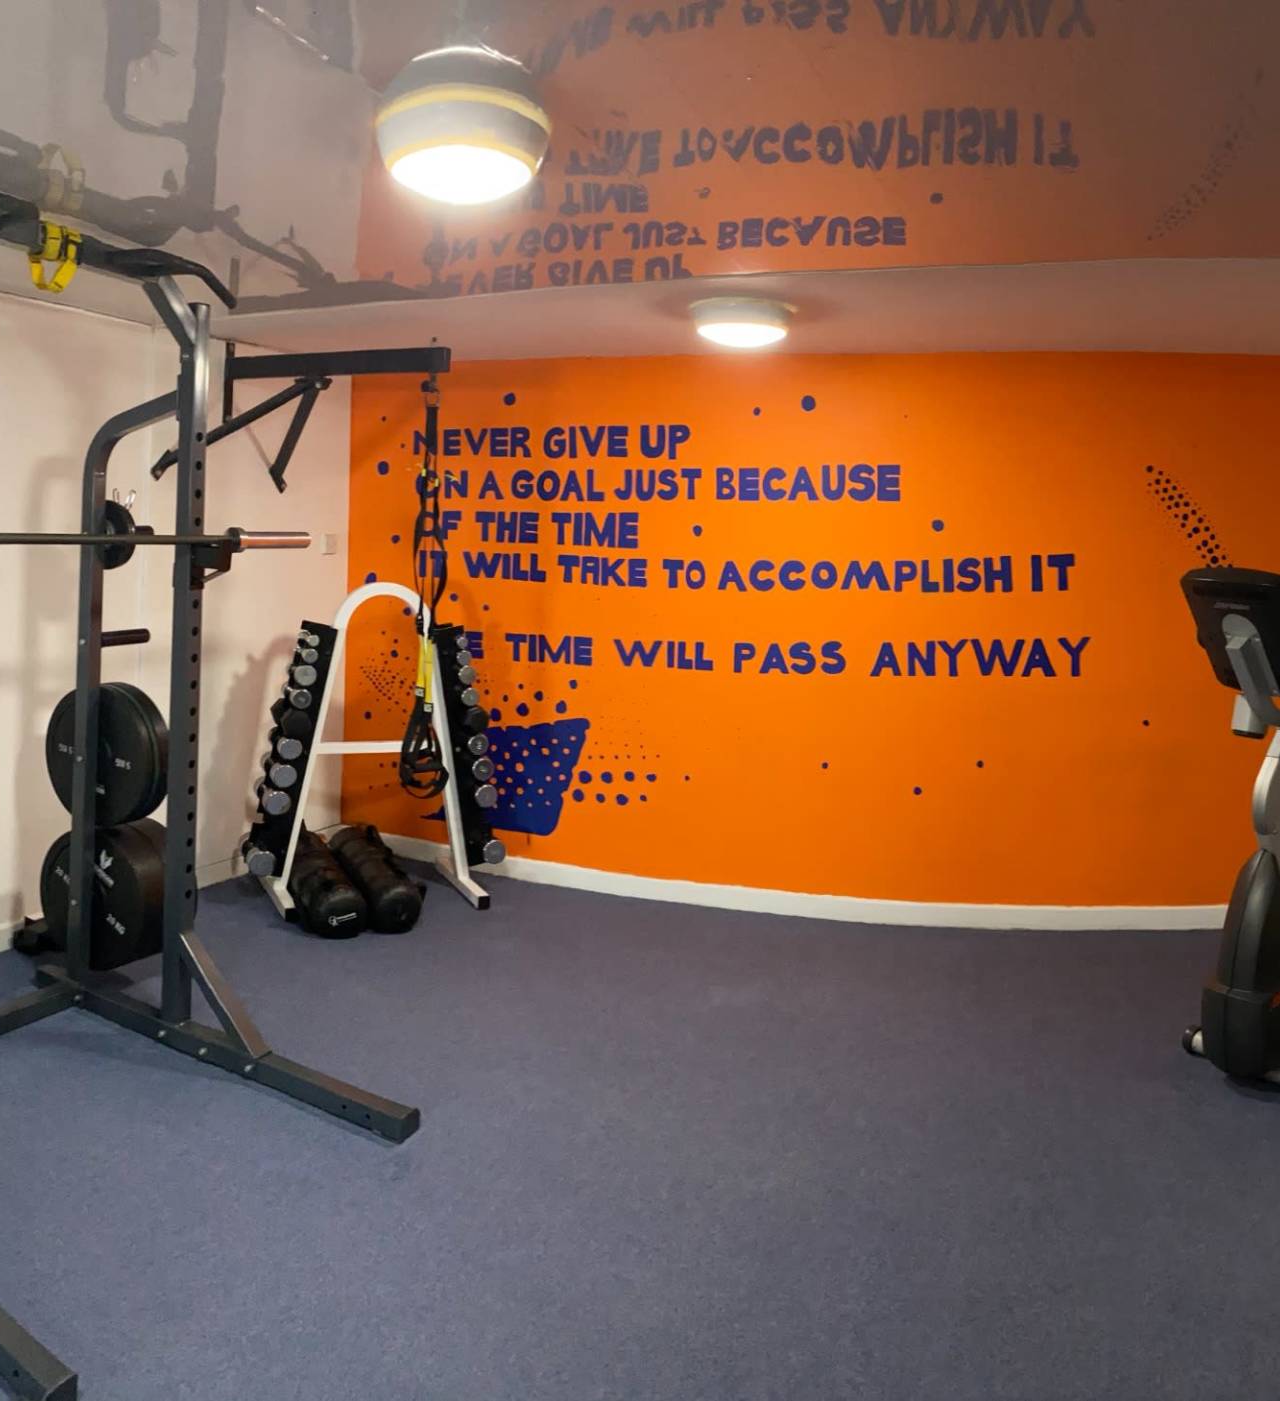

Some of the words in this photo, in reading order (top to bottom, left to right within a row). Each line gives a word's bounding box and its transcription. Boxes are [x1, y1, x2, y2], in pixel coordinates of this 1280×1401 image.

[543, 425, 629, 459] GIVE
[640, 424, 691, 460] UP
[478, 470, 505, 501] A
[511, 469, 606, 502] GOAL
[613, 468, 703, 501] JUST
[715, 463, 902, 502] BECAUSE
[475, 510, 540, 545] THE
[551, 511, 640, 550] TIME
[418, 549, 448, 579] IT
[463, 551, 547, 583] WILL
[557, 554, 649, 588] TAKE
[662, 558, 706, 590] TO
[716, 554, 1014, 594] ACCOMPLISH
[1030, 552, 1076, 593] IT
[504, 632, 594, 667] TIME
[613, 638, 714, 672] WILL
[732, 640, 847, 675] PASS
[869, 636, 1092, 678] ANYWAY
